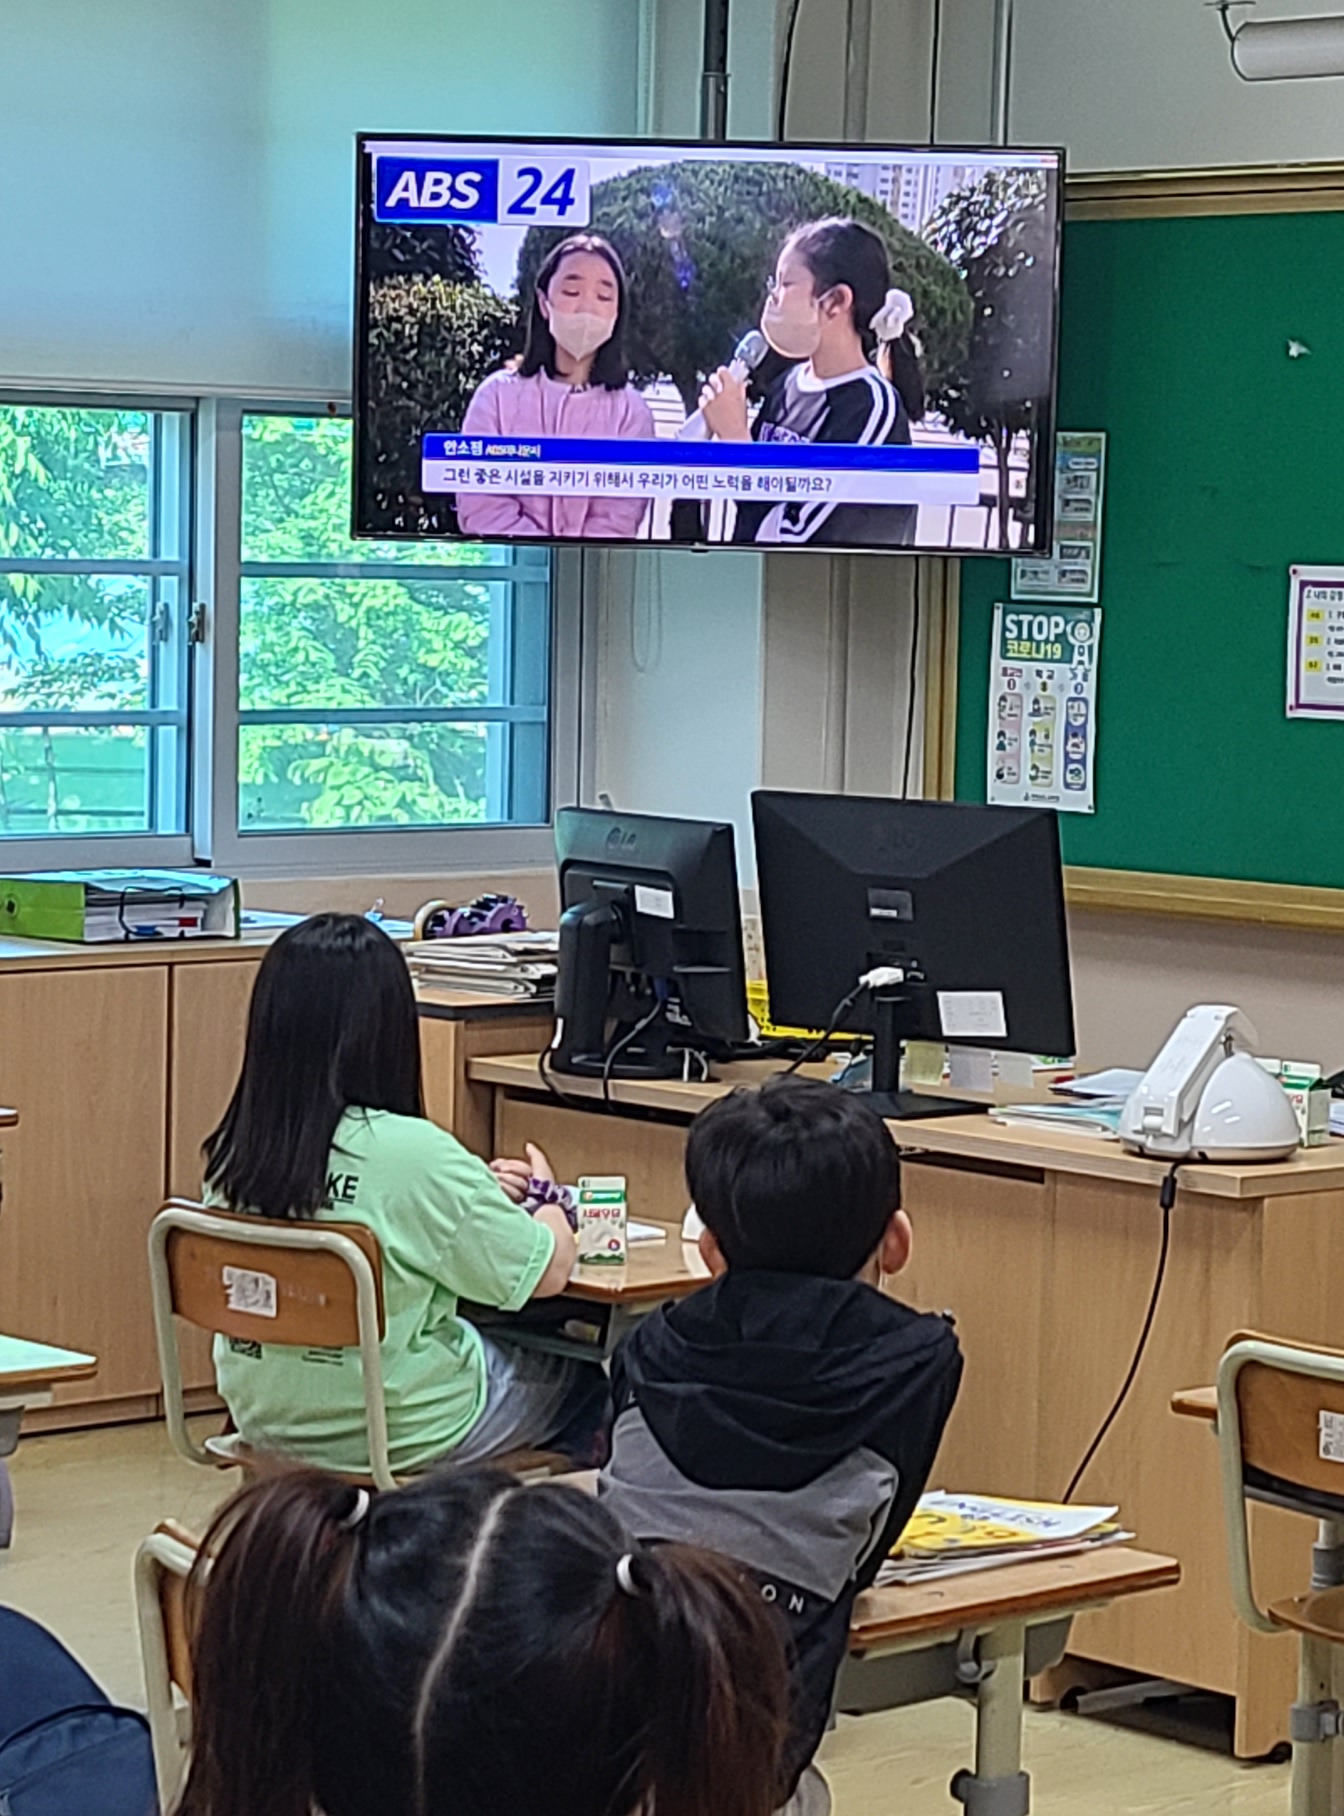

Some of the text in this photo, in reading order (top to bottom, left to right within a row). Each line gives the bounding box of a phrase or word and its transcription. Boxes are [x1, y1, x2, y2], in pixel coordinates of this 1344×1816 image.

[384, 166, 576, 216] ABS 24
[474, 467, 502, 485] 좋은
[505, 468, 545, 487] 시설을
[549, 470, 590, 488] 지키기
[593, 471, 634, 488] 위해서
[637, 471, 678, 490] 우리가
[681, 473, 709, 491] 어떤
[712, 474, 753, 492] 노력을
[1005, 613, 1065, 642] STOP
[1005, 640, 1062, 659] 코로나19
